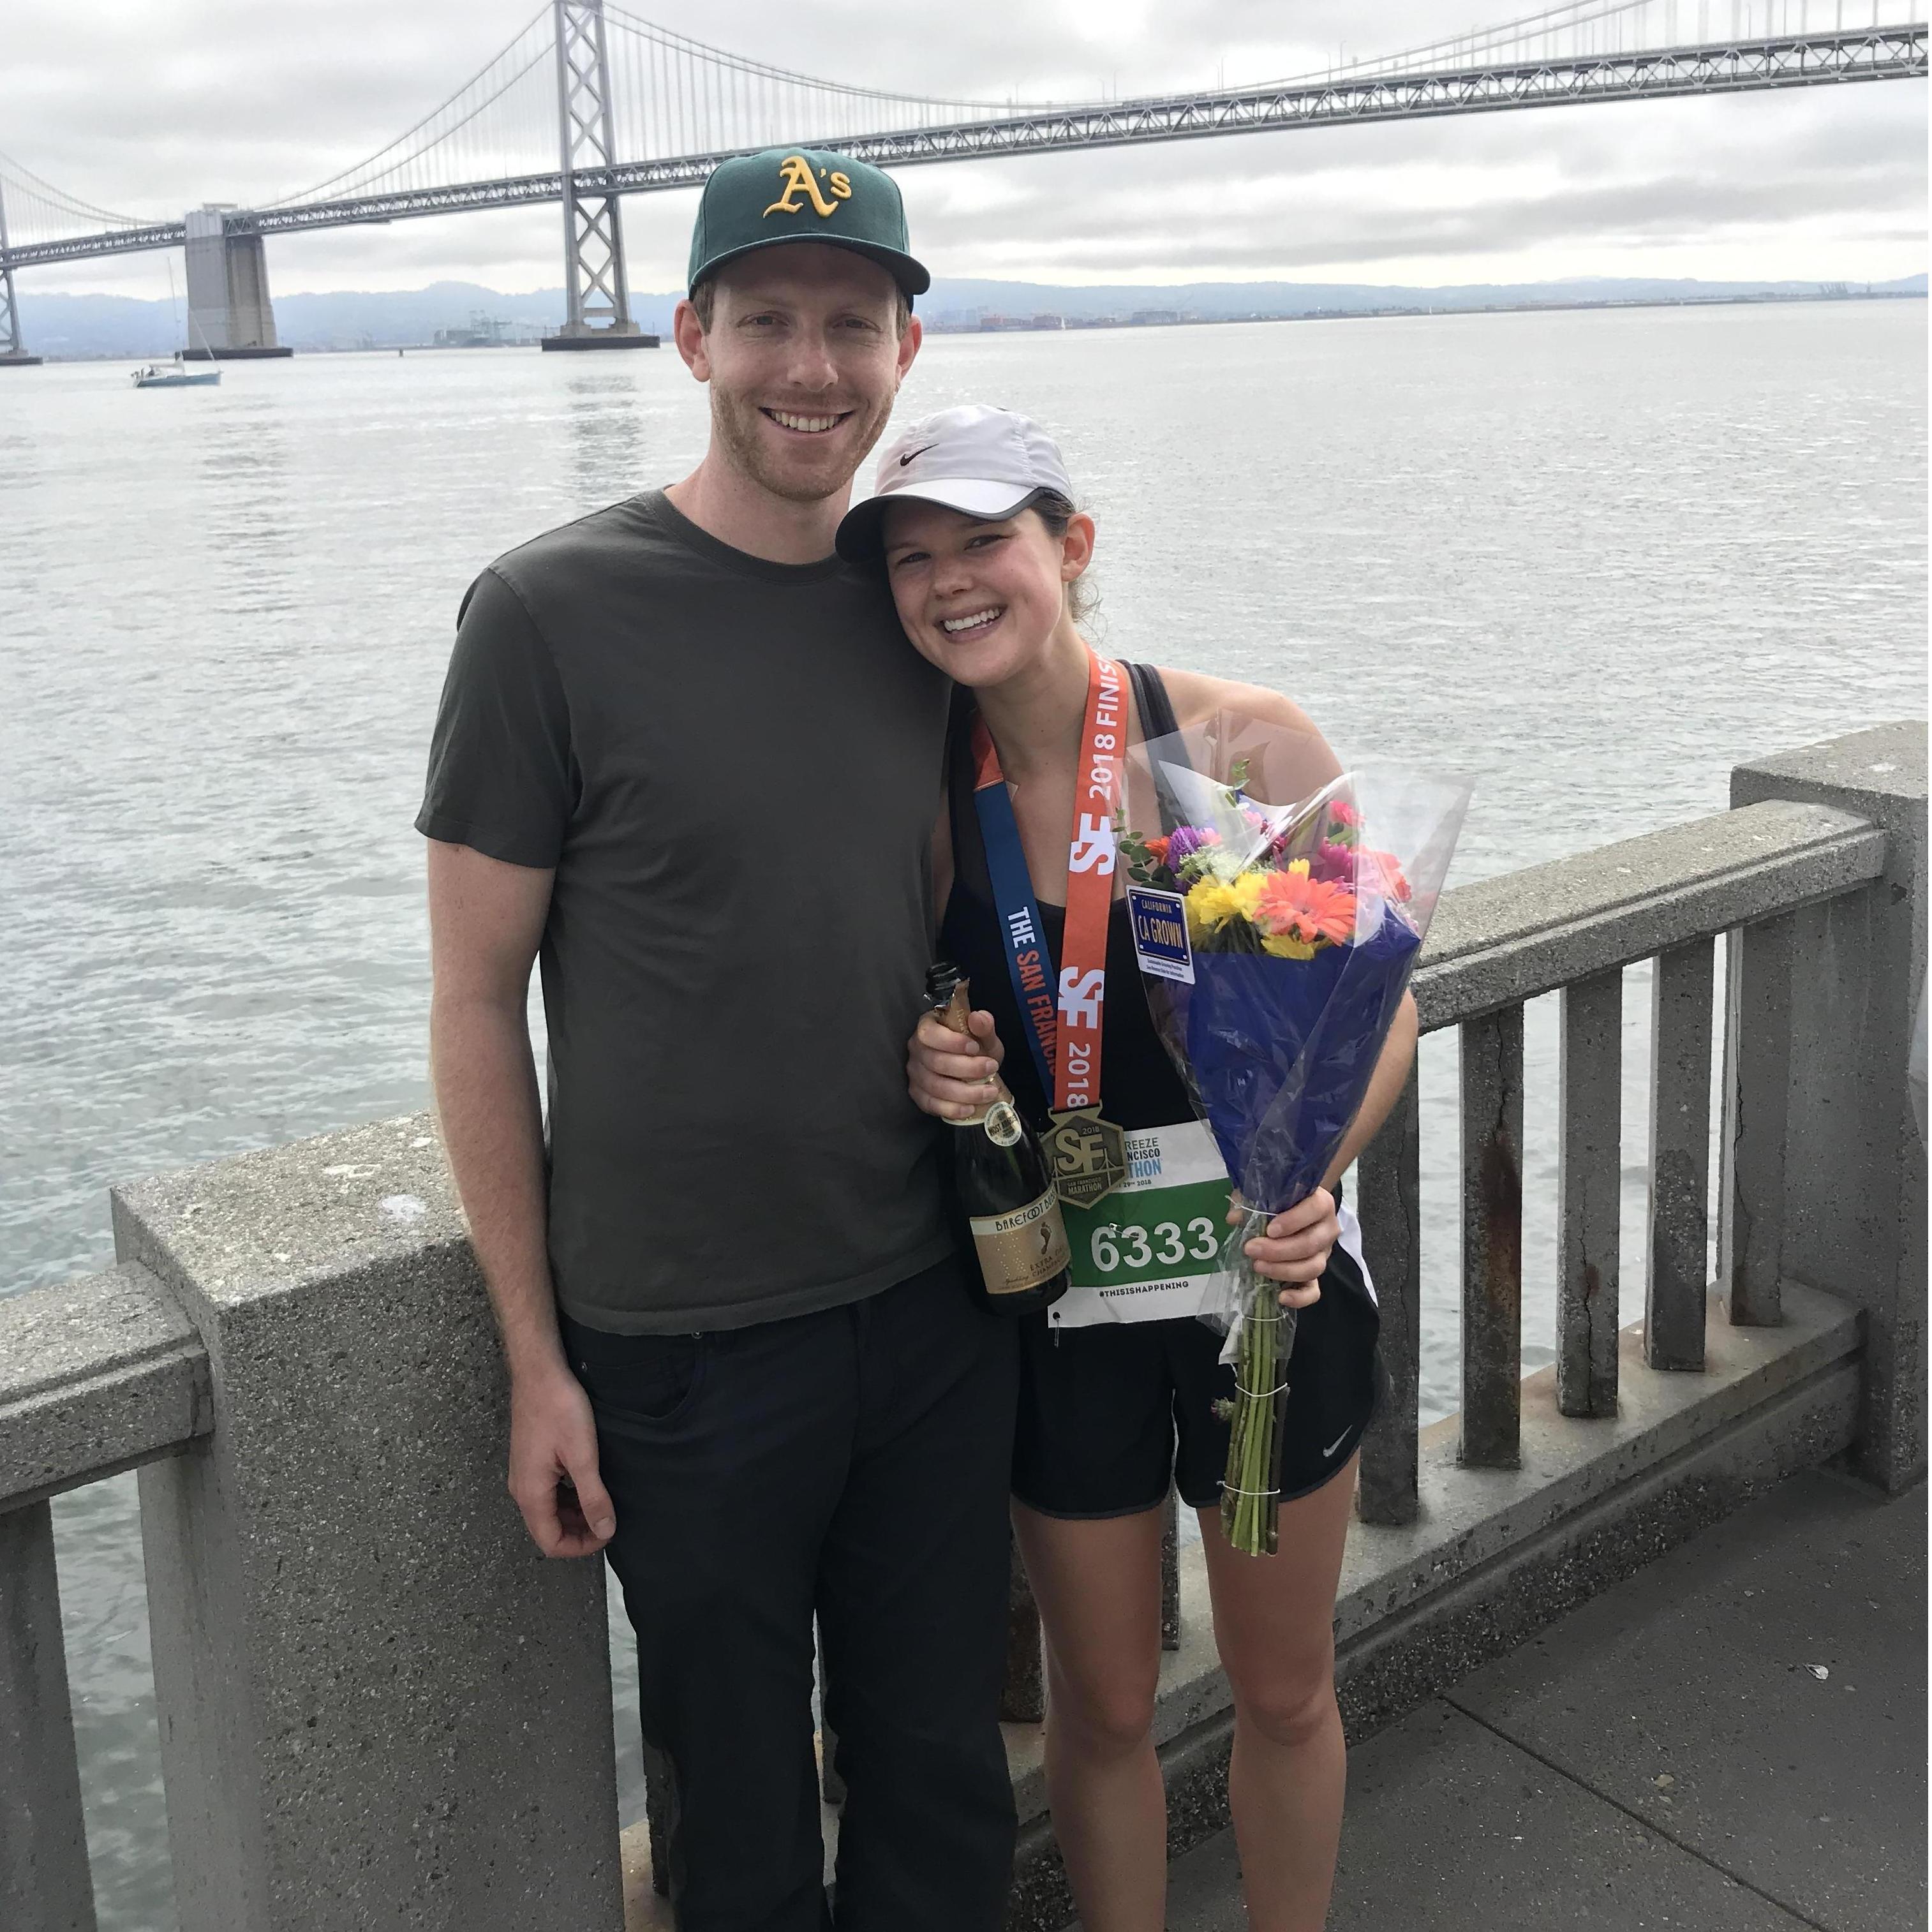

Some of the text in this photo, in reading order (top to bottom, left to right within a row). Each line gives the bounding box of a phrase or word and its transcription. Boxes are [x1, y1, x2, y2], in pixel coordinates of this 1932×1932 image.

[763, 156, 852, 218] A's
[1089, 734, 1115, 800] 2018
[1069, 813, 1116, 875] SF
[1141, 899, 1173, 914] CALIFORNIA
[1007, 906, 1036, 949] THE
[1138, 914, 1184, 949] CA GROWN
[1016, 949, 1046, 992] SAN
[1058, 967, 1104, 1108] SF 2018
[1082, 1126, 1100, 1134] 2018
[1125, 1137, 1159, 1150] REEZE
[1055, 1128, 1104, 1175] SF
[1127, 1148, 1161, 1161] NCISCO
[1067, 1182, 1102, 1196] MARATHON
[1136, 1178, 1152, 1187] 2018
[995, 1203, 1044, 1231] BAREFOOT
[1090, 1217, 1219, 1272] 6333
[1030, 1255, 1053, 1272] EXTRA
[1099, 1281, 1189, 1298] #THISISHAPPENING
